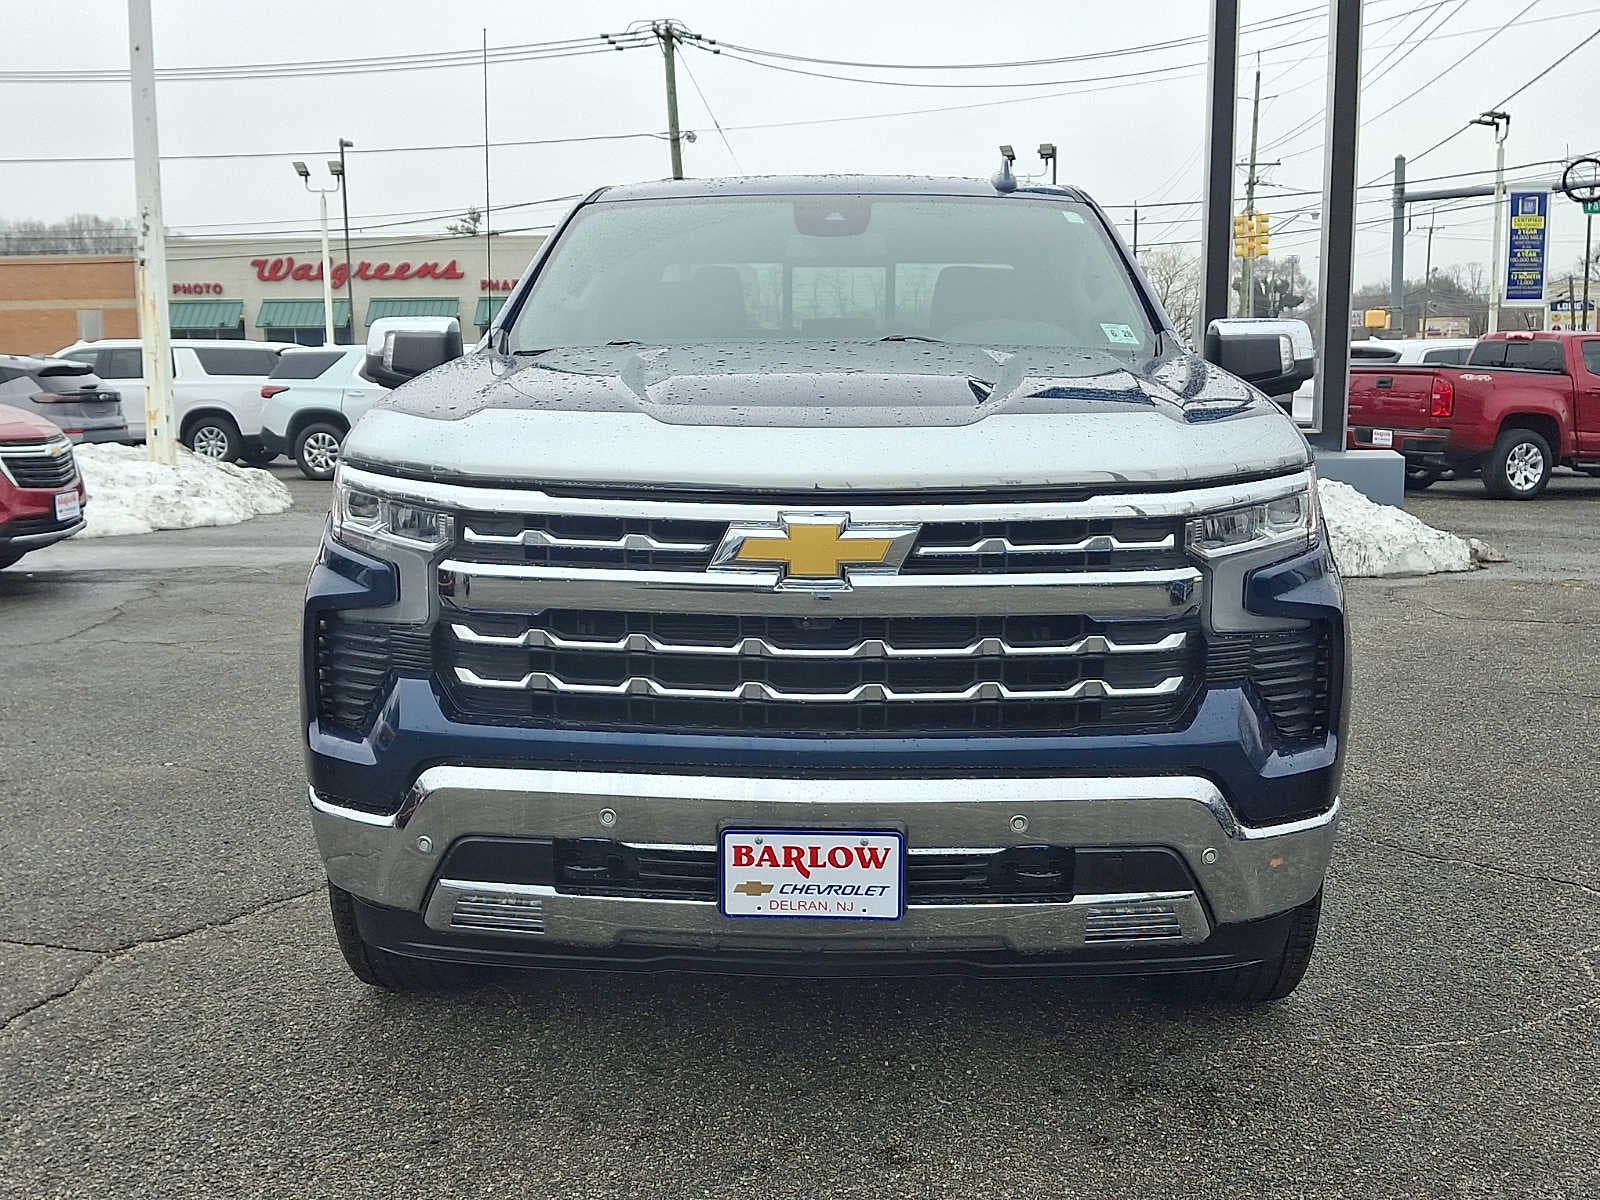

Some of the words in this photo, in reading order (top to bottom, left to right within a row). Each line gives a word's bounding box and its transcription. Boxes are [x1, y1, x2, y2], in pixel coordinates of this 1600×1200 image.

[172, 283, 223, 295] PHOTO
[732, 845, 891, 879] BARLOW
[779, 883, 891, 897] CHEVROLET
[769, 900, 832, 912] DELRAN,
[836, 901, 854, 911] NJ
